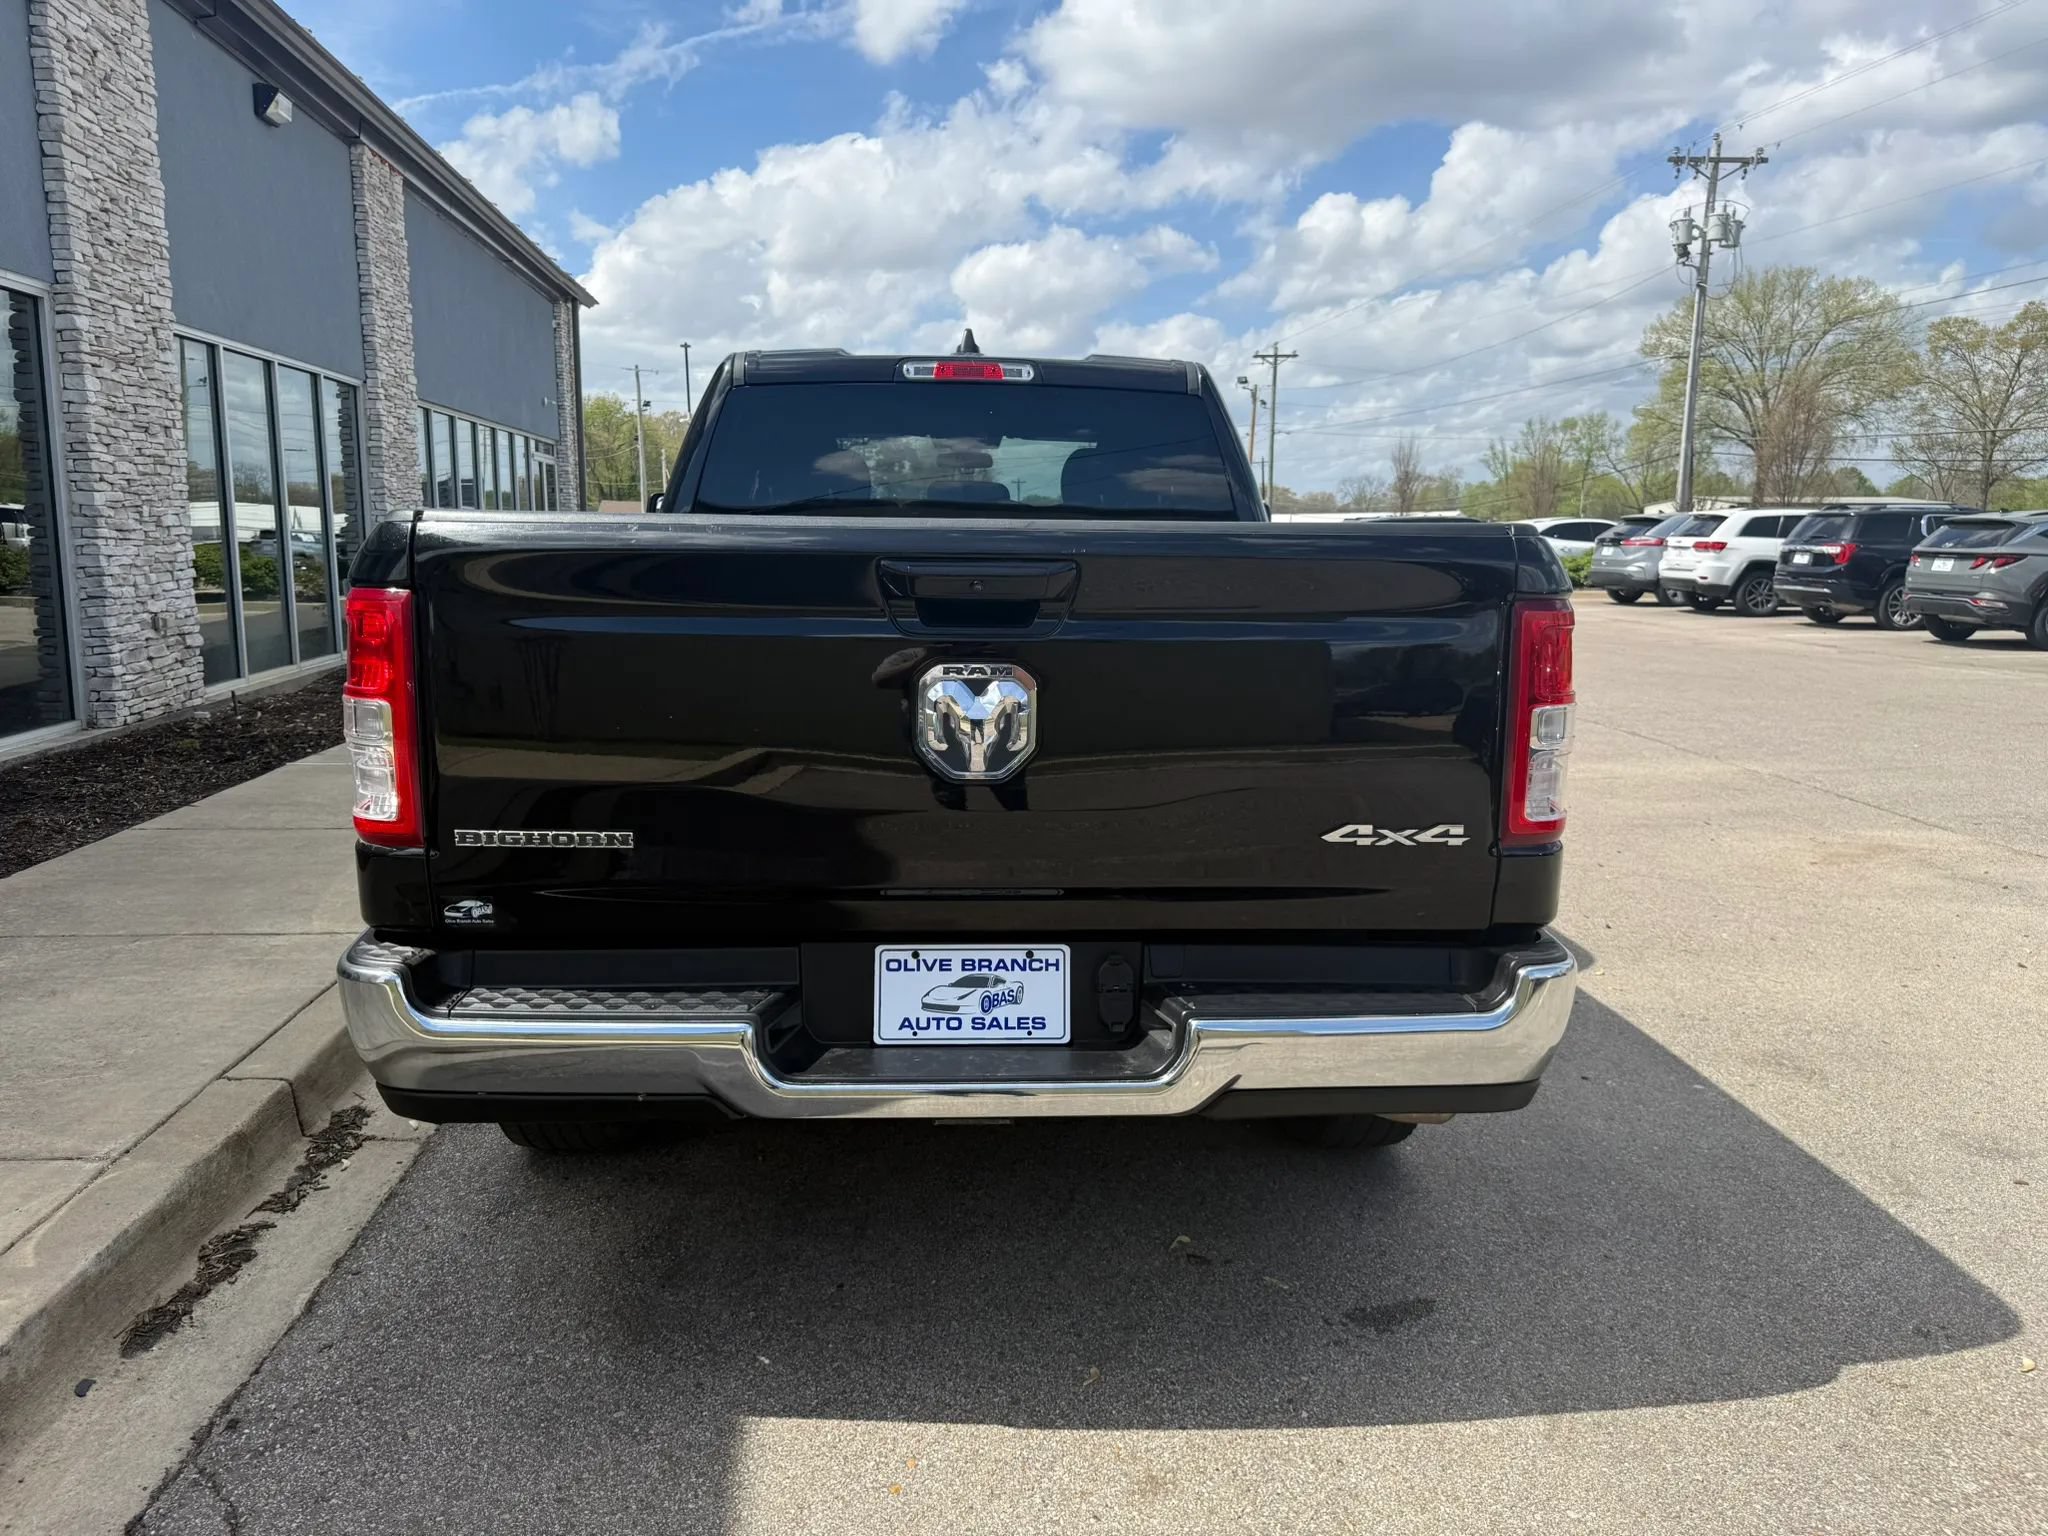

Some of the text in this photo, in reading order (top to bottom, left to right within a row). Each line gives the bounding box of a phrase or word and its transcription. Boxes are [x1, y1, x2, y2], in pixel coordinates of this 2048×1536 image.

[942, 666, 1013, 676] RAM
[454, 829, 634, 848] BIGHORN
[1320, 824, 1471, 846] 4x4
[886, 958, 1060, 972] OLIVE BRANCH
[898, 1017, 1047, 1031] AUTO SALES
